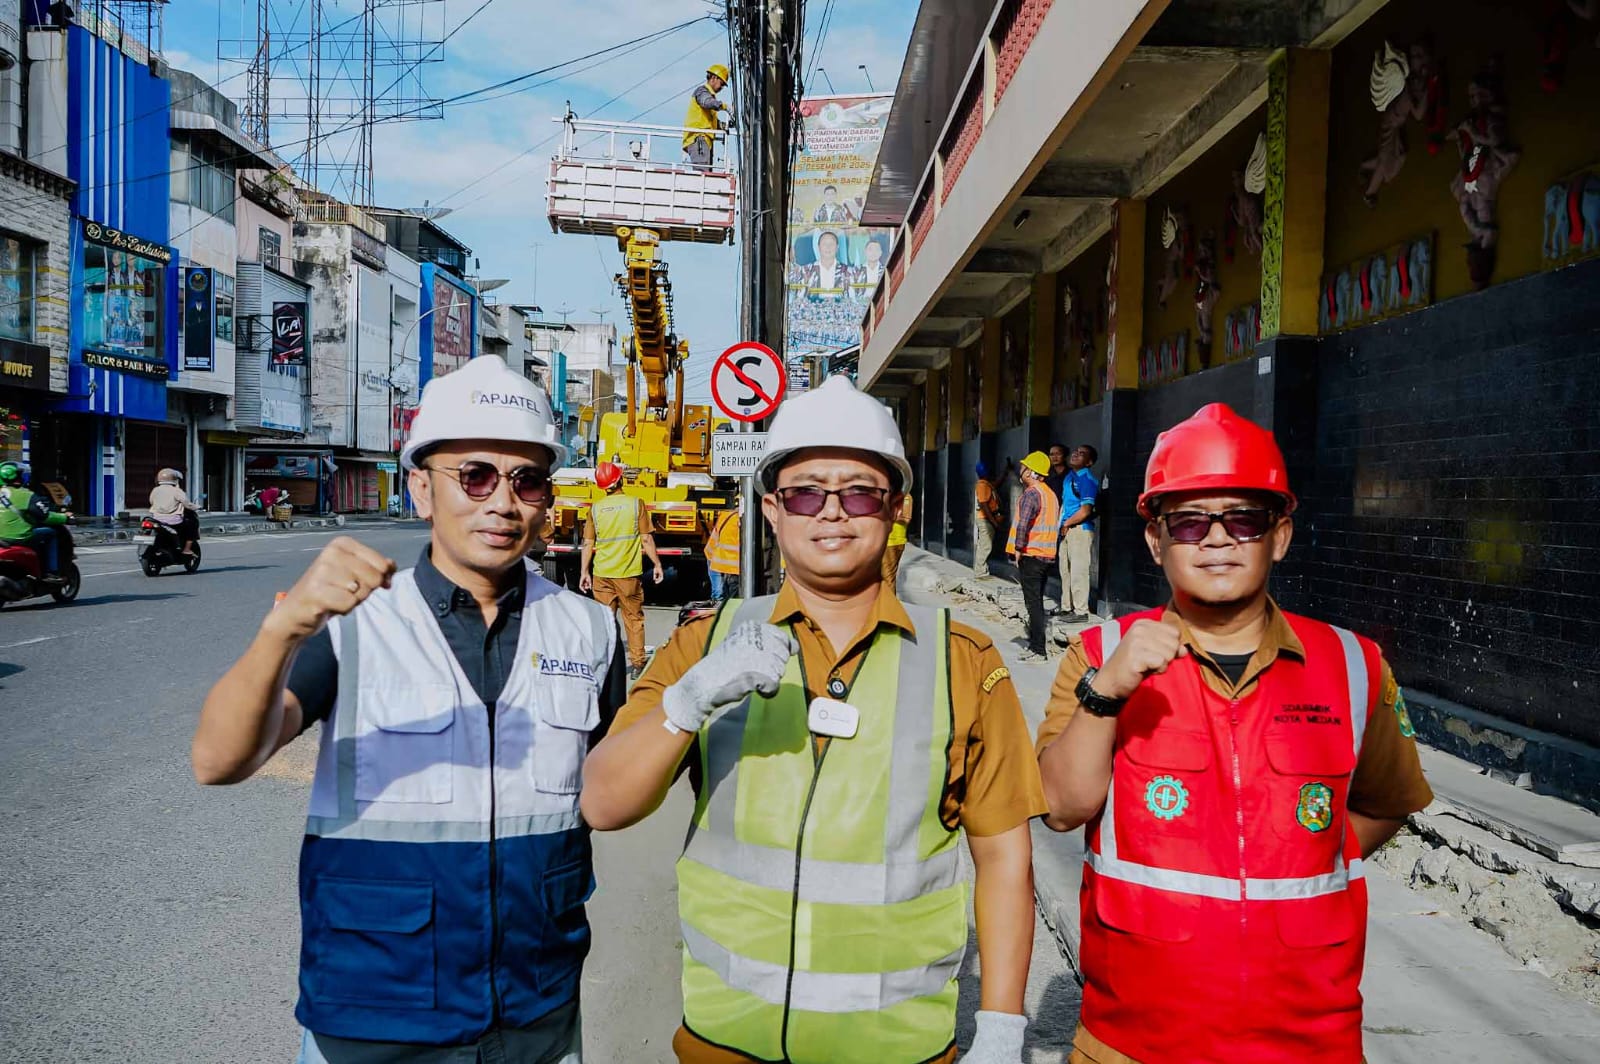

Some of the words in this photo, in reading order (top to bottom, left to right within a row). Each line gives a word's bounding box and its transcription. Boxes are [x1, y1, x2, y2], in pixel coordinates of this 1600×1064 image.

[86, 353, 115, 367] TAILOR
[116, 358, 123, 368] &
[479, 393, 541, 414] APJATEL
[715, 440, 748, 452] SAMPAI
[721, 456, 761, 467] BERIKUT
[541, 659, 594, 678] APJATEL
[1274, 715, 1301, 724] KOTA
[1306, 715, 1342, 726] MEDAN
